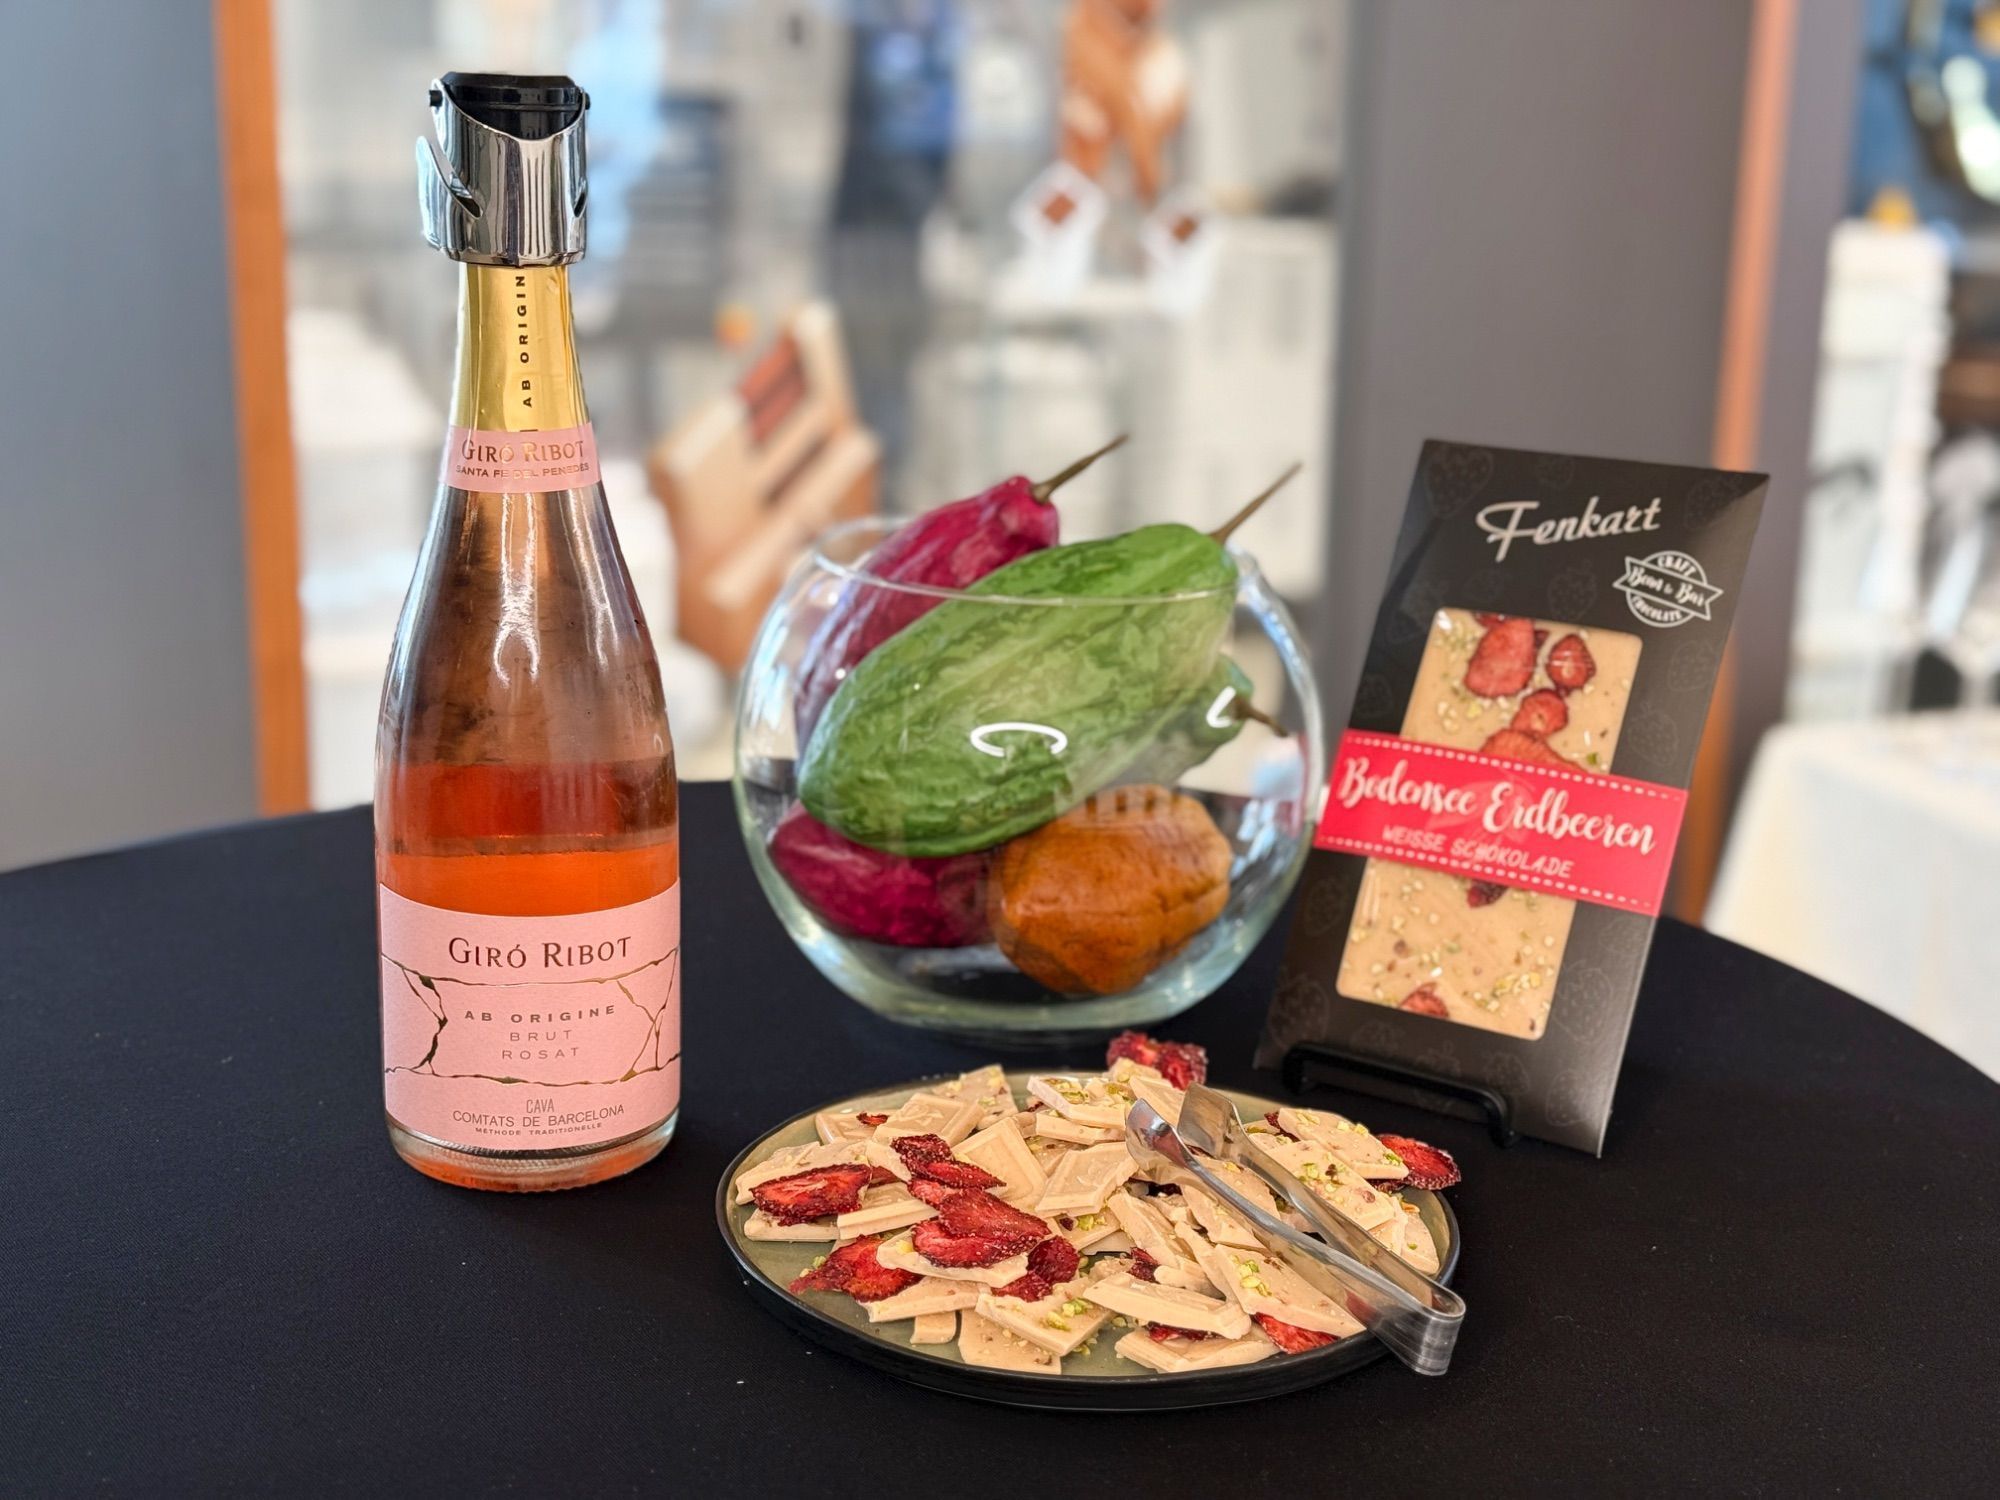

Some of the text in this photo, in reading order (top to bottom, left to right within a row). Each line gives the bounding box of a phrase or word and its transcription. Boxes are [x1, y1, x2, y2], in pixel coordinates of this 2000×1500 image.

[515, 276, 532, 408] AB ORIGIN
[521, 440, 584, 462] RIBOT
[456, 465, 489, 477] SANTA
[493, 469, 510, 478] FE
[513, 469, 539, 480] DEL
[1476, 496, 1662, 563] Fenkart
[1657, 555, 1696, 576] CRAFT
[1628, 566, 1664, 591] Bean
[1675, 582, 1705, 607] Bar
[1632, 595, 1683, 622] CHOCOLATE
[1337, 757, 1657, 855] Bodensee Erdbeeren
[1382, 825, 1575, 878] WEISSE SCHOKOLADE
[448, 936, 632, 968] GIRÓ RIBOT
[464, 1005, 616, 1023] AB ORIGINE
[510, 1030, 573, 1042] BRUT
[501, 1047, 580, 1060] ROSAT
[452, 1104, 625, 1128] COMTATS DE BARCELONA
[526, 1098, 555, 1114] CAVA
[528, 1122, 603, 1136] TRADITIONELLE
